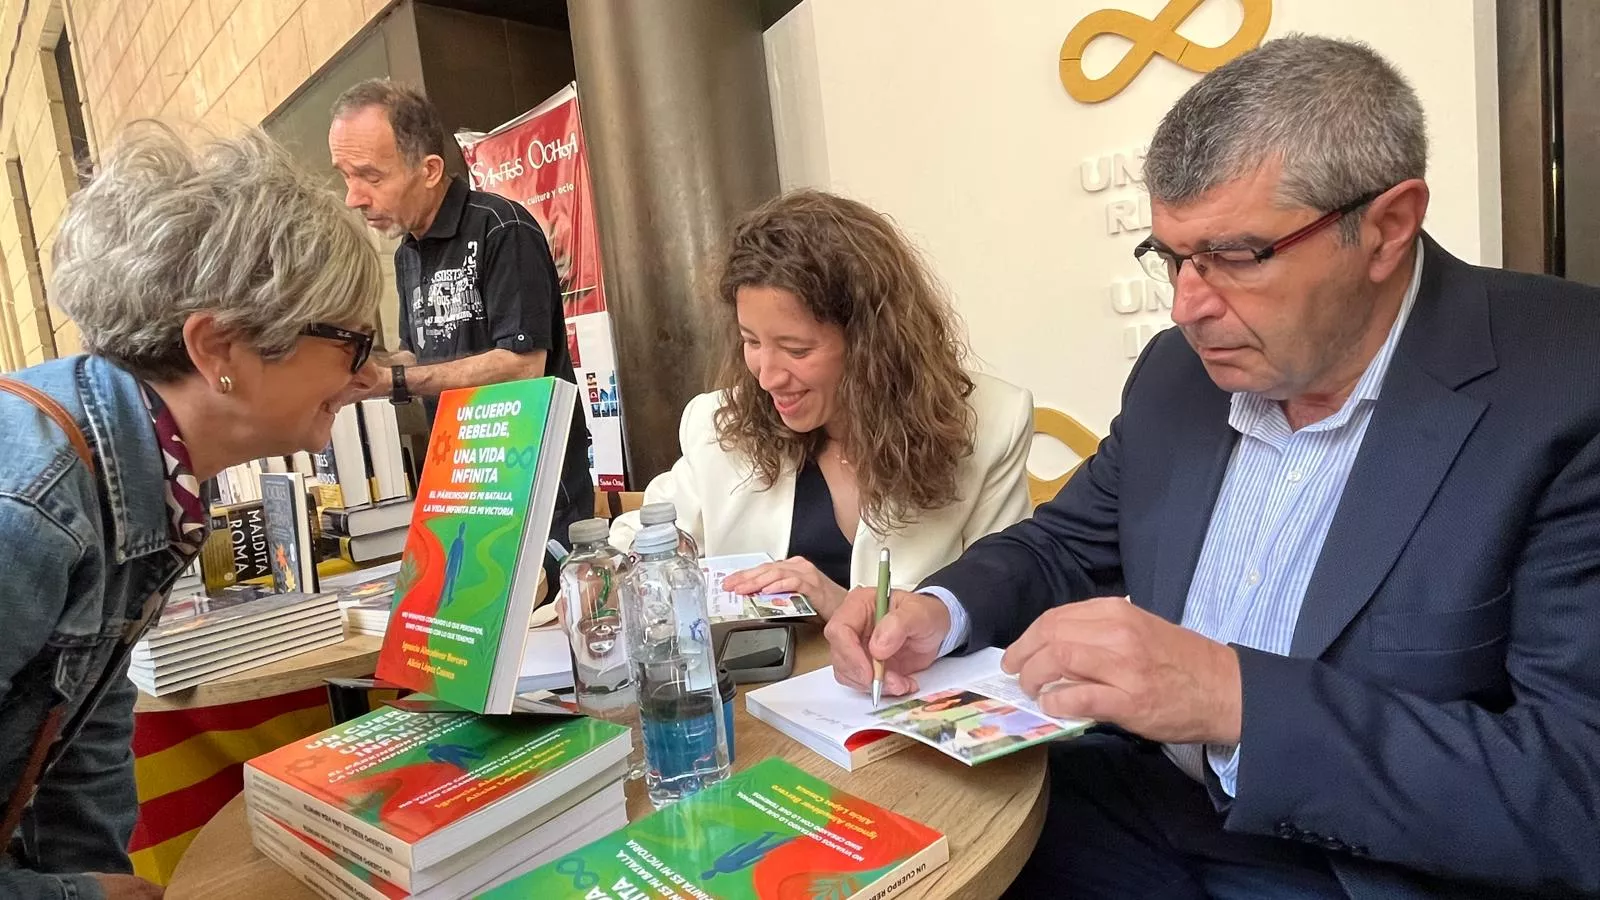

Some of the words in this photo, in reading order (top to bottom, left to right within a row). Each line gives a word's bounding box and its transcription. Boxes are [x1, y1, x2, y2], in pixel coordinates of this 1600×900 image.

[527, 192, 551, 206] cultura
[551, 190, 556, 199] y
[558, 183, 574, 193] ocio
[457, 407, 474, 421] UN
[474, 400, 521, 419] CUERPO
[458, 422, 510, 440] REBELDE,
[453, 449, 476, 464] UNA
[479, 447, 505, 463] VIDA
[451, 468, 498, 483] INFINITA
[469, 491, 477, 500] ES
[485, 507, 513, 516] VICTORIA
[229, 519, 249, 575] ROMA
[247, 509, 268, 575] MALDITA
[305, 734, 340, 749] UN
[344, 710, 400, 735] CUER
[327, 712, 419, 749] REBELD
[355, 717, 452, 757] INFINITA
[339, 733, 392, 755] UNA
[328, 774, 347, 784] LA
[349, 762, 377, 776] VIDA
[377, 740, 427, 764] INFINITA
[845, 823, 877, 840] Ignacio
[626, 839, 664, 869] VICTORIA
[660, 866, 675, 877] MI
[916, 863, 926, 874] UN
[648, 879, 663, 888] MI
[669, 874, 686, 885] ES
[887, 870, 916, 893] CUERPO
[658, 885, 674, 896] ES
